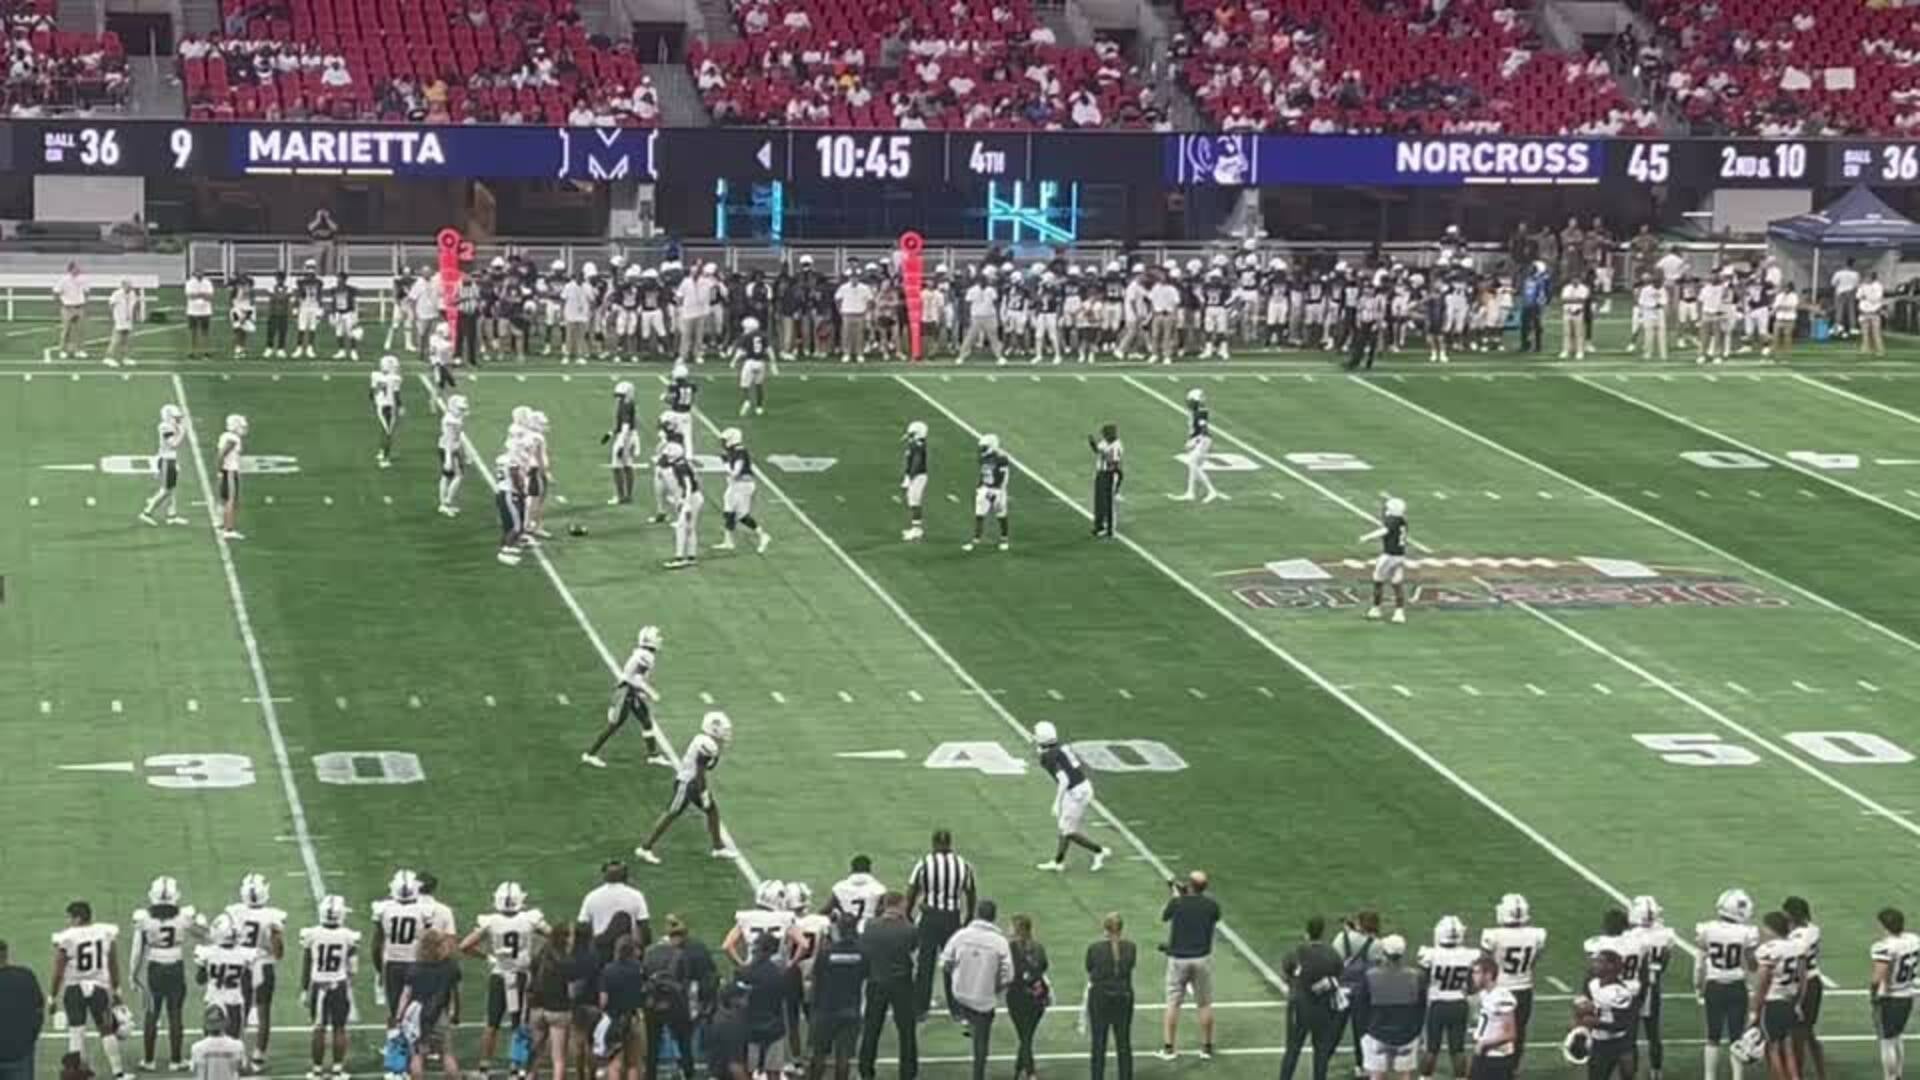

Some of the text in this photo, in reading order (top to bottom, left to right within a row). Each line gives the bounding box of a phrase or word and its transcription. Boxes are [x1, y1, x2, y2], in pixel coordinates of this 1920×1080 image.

[80, 128, 119, 165] 36
[171, 128, 193, 168] 9
[249, 130, 446, 164] MARIETTA
[816, 134, 911, 178] 10:45
[969, 141, 1006, 174] 4TH
[1396, 141, 1590, 173] NORCROSS
[1776, 144, 1806, 177] 10
[1628, 144, 1670, 182] 45
[1882, 146, 1918, 179] 36
[458, 242, 475, 261] 2
[850, 898, 866, 920] 7
[159, 926, 175, 948] 3
[242, 921, 259, 948] 3
[390, 916, 416, 945] 10
[503, 931, 520, 959] 9
[77, 939, 103, 972] 61
[316, 943, 342, 973] 16
[1504, 946, 1532, 975] 51
[1710, 942, 1742, 970] 20
[210, 963, 241, 989] 42
[1434, 965, 1467, 991] 46
